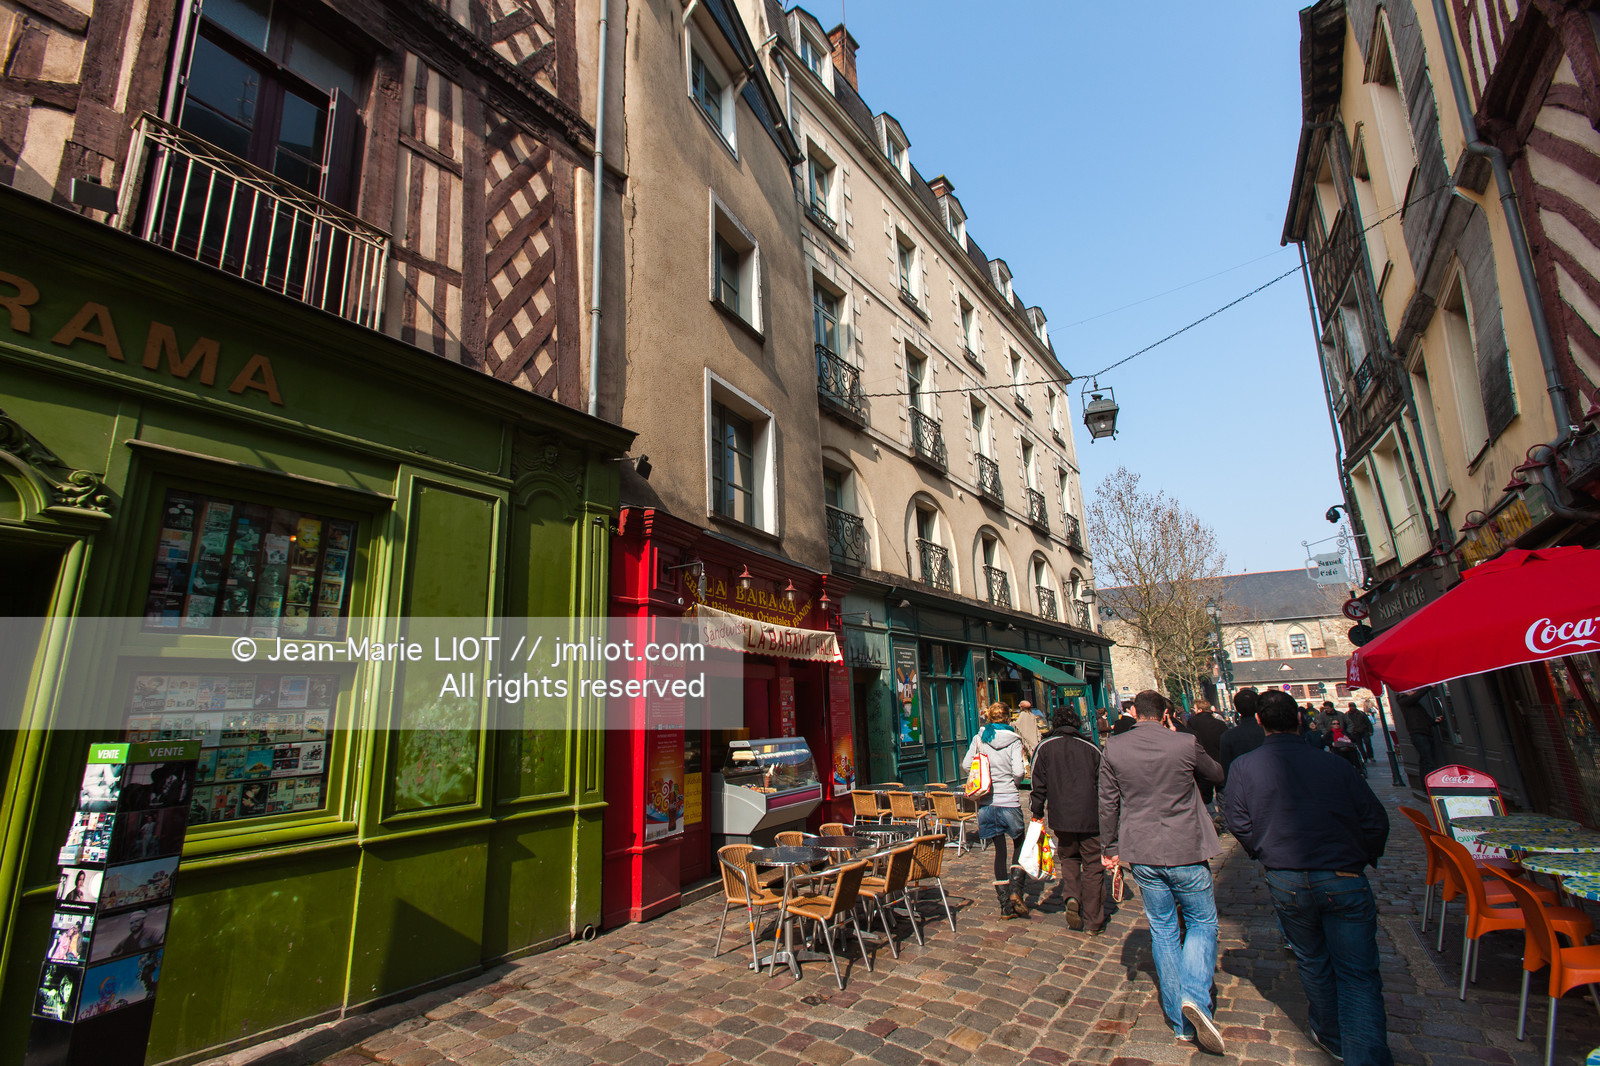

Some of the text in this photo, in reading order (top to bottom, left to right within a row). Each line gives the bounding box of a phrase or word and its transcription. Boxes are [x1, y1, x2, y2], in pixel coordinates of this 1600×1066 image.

[1497, 498, 1532, 541] 2000
[1318, 558, 1342, 567] Sunset
[735, 584, 797, 614] BARAKA
[748, 625, 765, 649] LA
[768, 629, 811, 655] BARAKA
[97, 749, 120, 759] VENTE
[150, 746, 184, 757] VENTE
[1457, 807, 1483, 816] 2000
